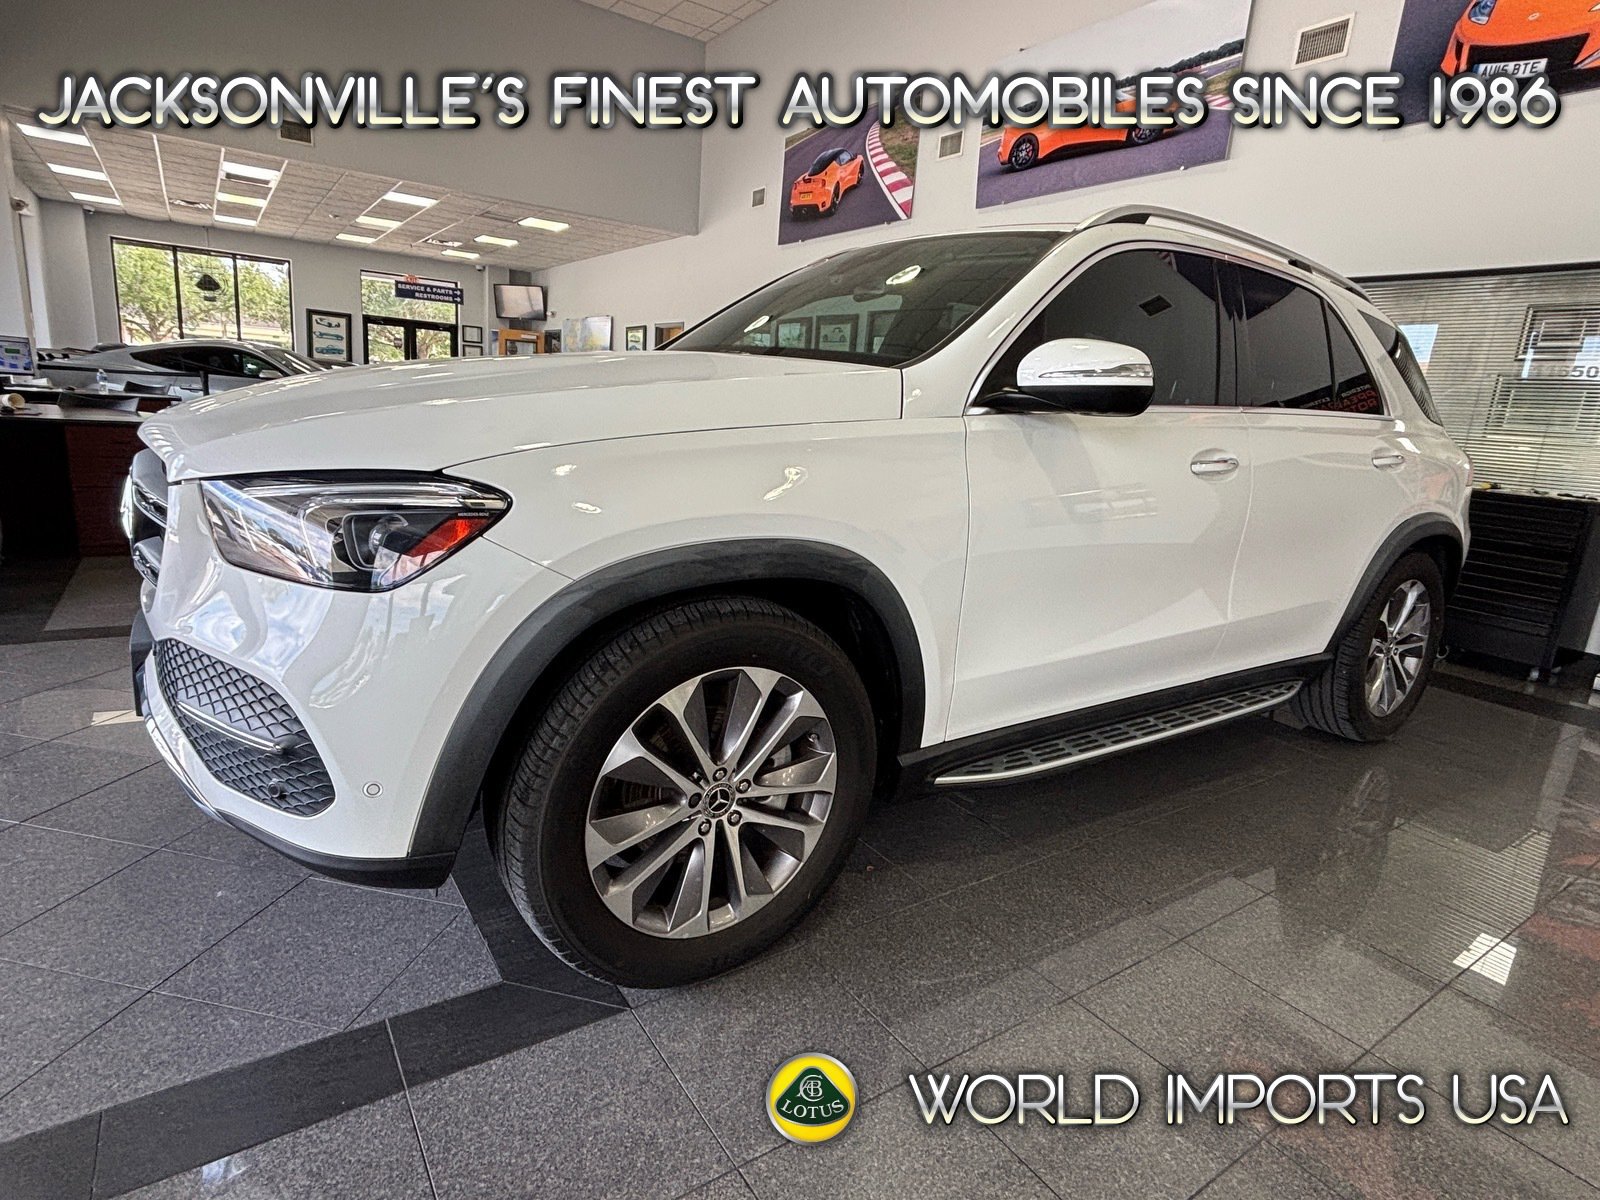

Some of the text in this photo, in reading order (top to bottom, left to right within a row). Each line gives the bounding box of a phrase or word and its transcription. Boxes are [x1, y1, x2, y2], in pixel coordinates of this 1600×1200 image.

[1512, 61, 1541, 75] BTE
[397, 283, 425, 291] SERVICE
[432, 287, 453, 295] PARTS
[414, 292, 453, 301] RESTROOMS
